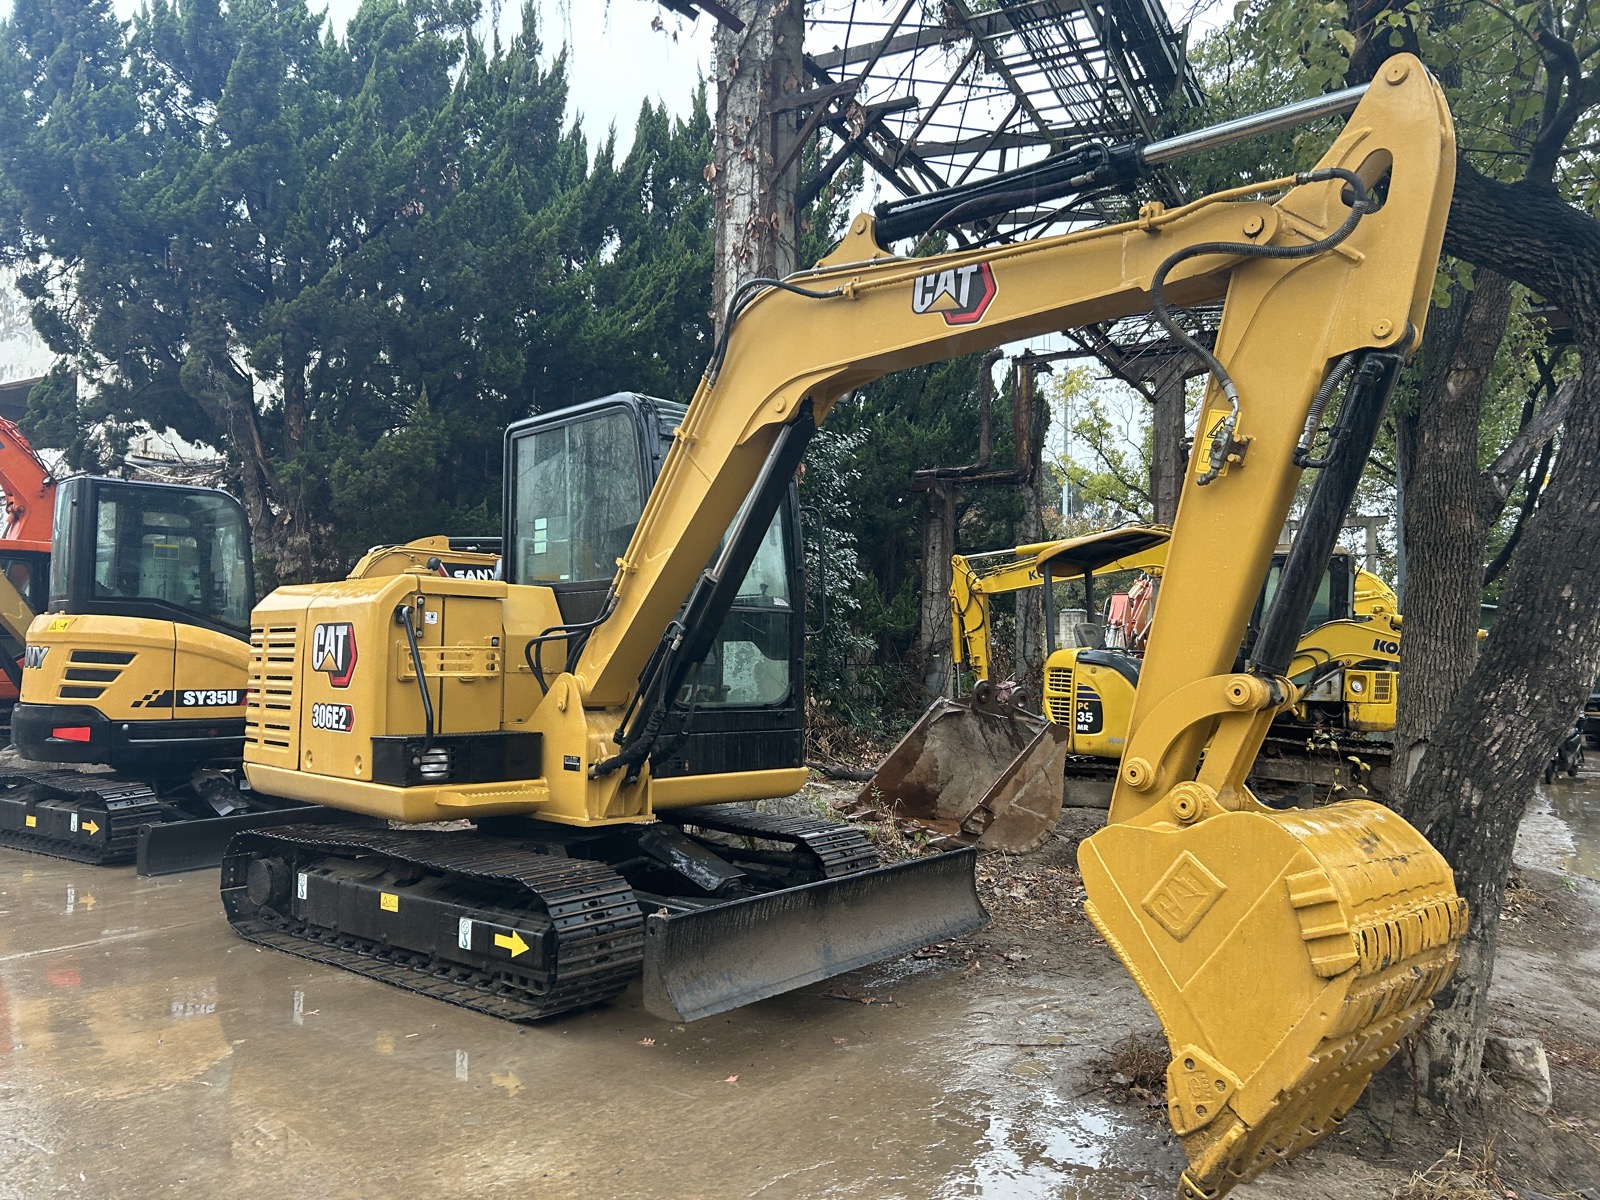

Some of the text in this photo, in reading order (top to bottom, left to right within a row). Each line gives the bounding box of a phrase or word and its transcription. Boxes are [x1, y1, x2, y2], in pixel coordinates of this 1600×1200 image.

[913, 264, 978, 313] CAT
[313, 624, 348, 671] CAT
[1373, 638, 1401, 656] KO
[183, 690, 238, 705] SY35U
[1077, 702, 1089, 710] PC
[312, 703, 347, 730] 306E2
[1077, 711, 1094, 723] 35
[1150, 861, 1211, 930] CAT
